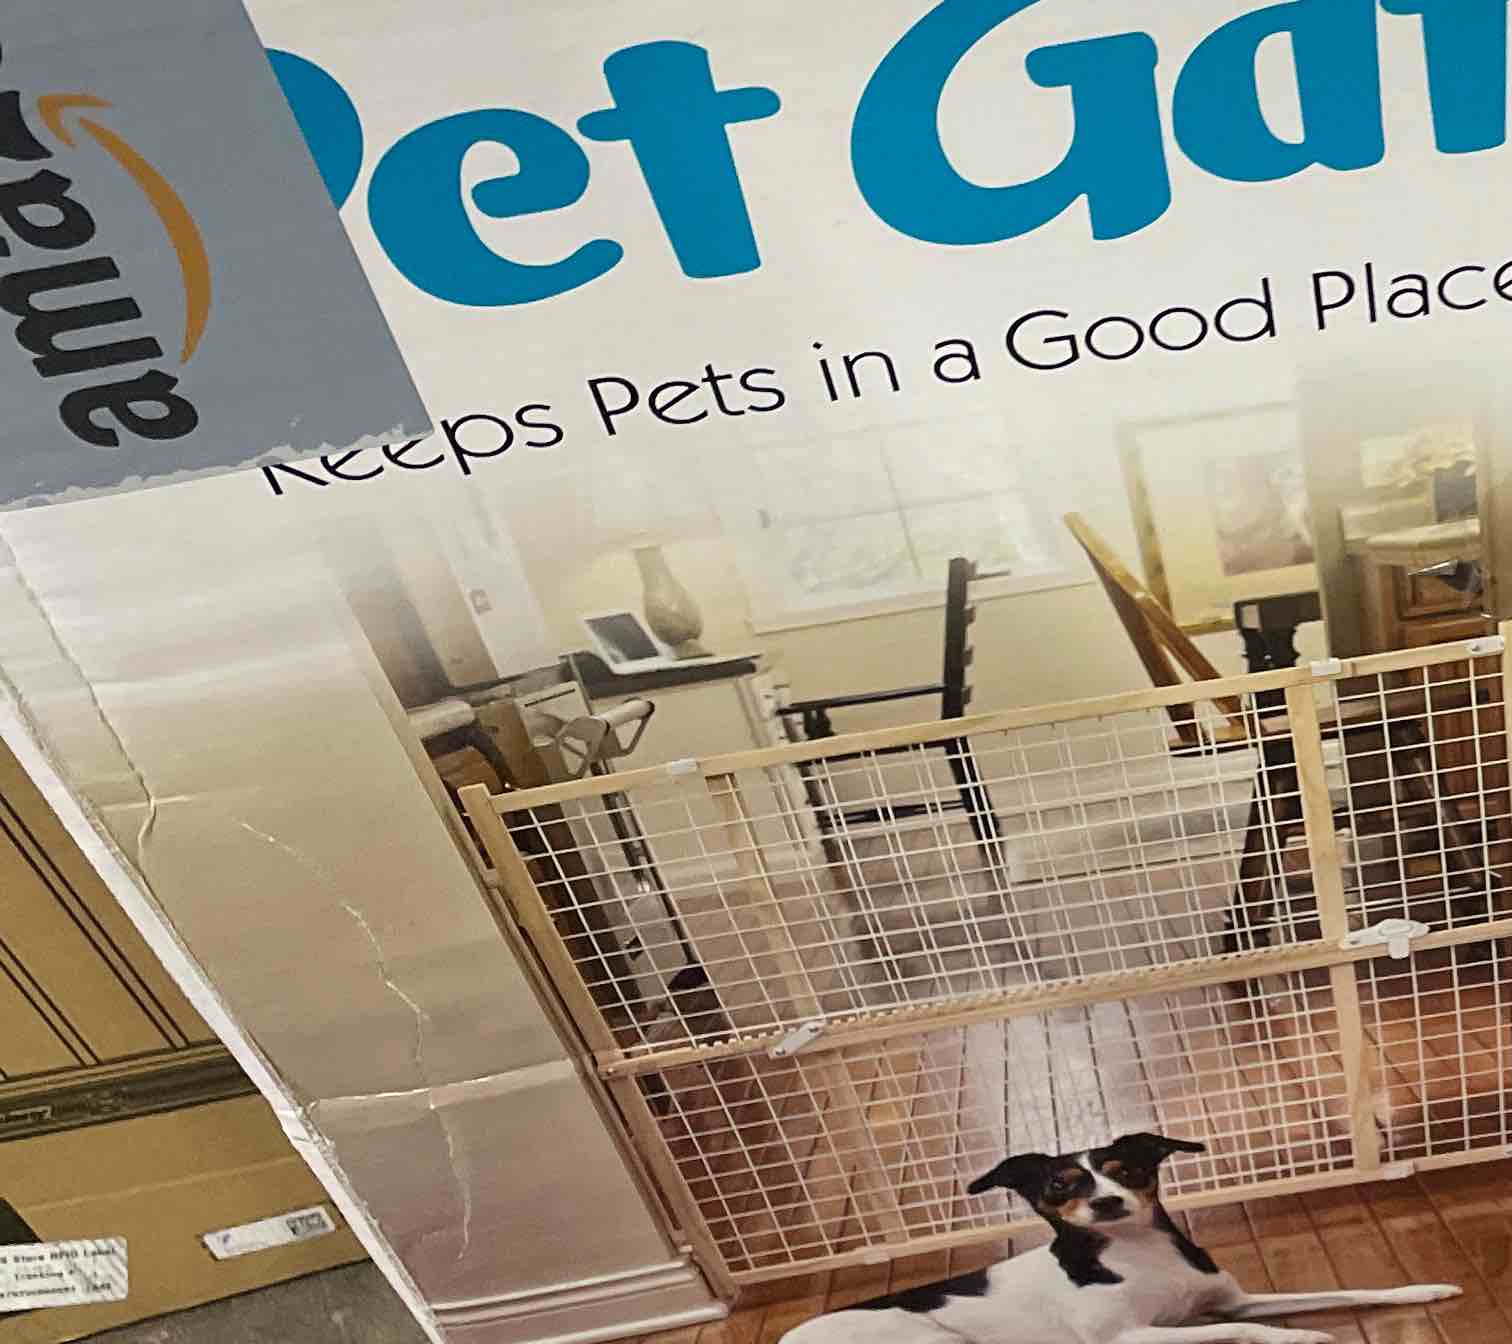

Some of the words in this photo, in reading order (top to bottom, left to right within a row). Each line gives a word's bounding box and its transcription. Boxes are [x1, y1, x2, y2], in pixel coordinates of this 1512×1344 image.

[0, 91, 199, 447] ama
[587, 362, 787, 436] Pets
[812, 342, 902, 402] in
[933, 336, 981, 383] a
[1005, 278, 1276, 372] Good
